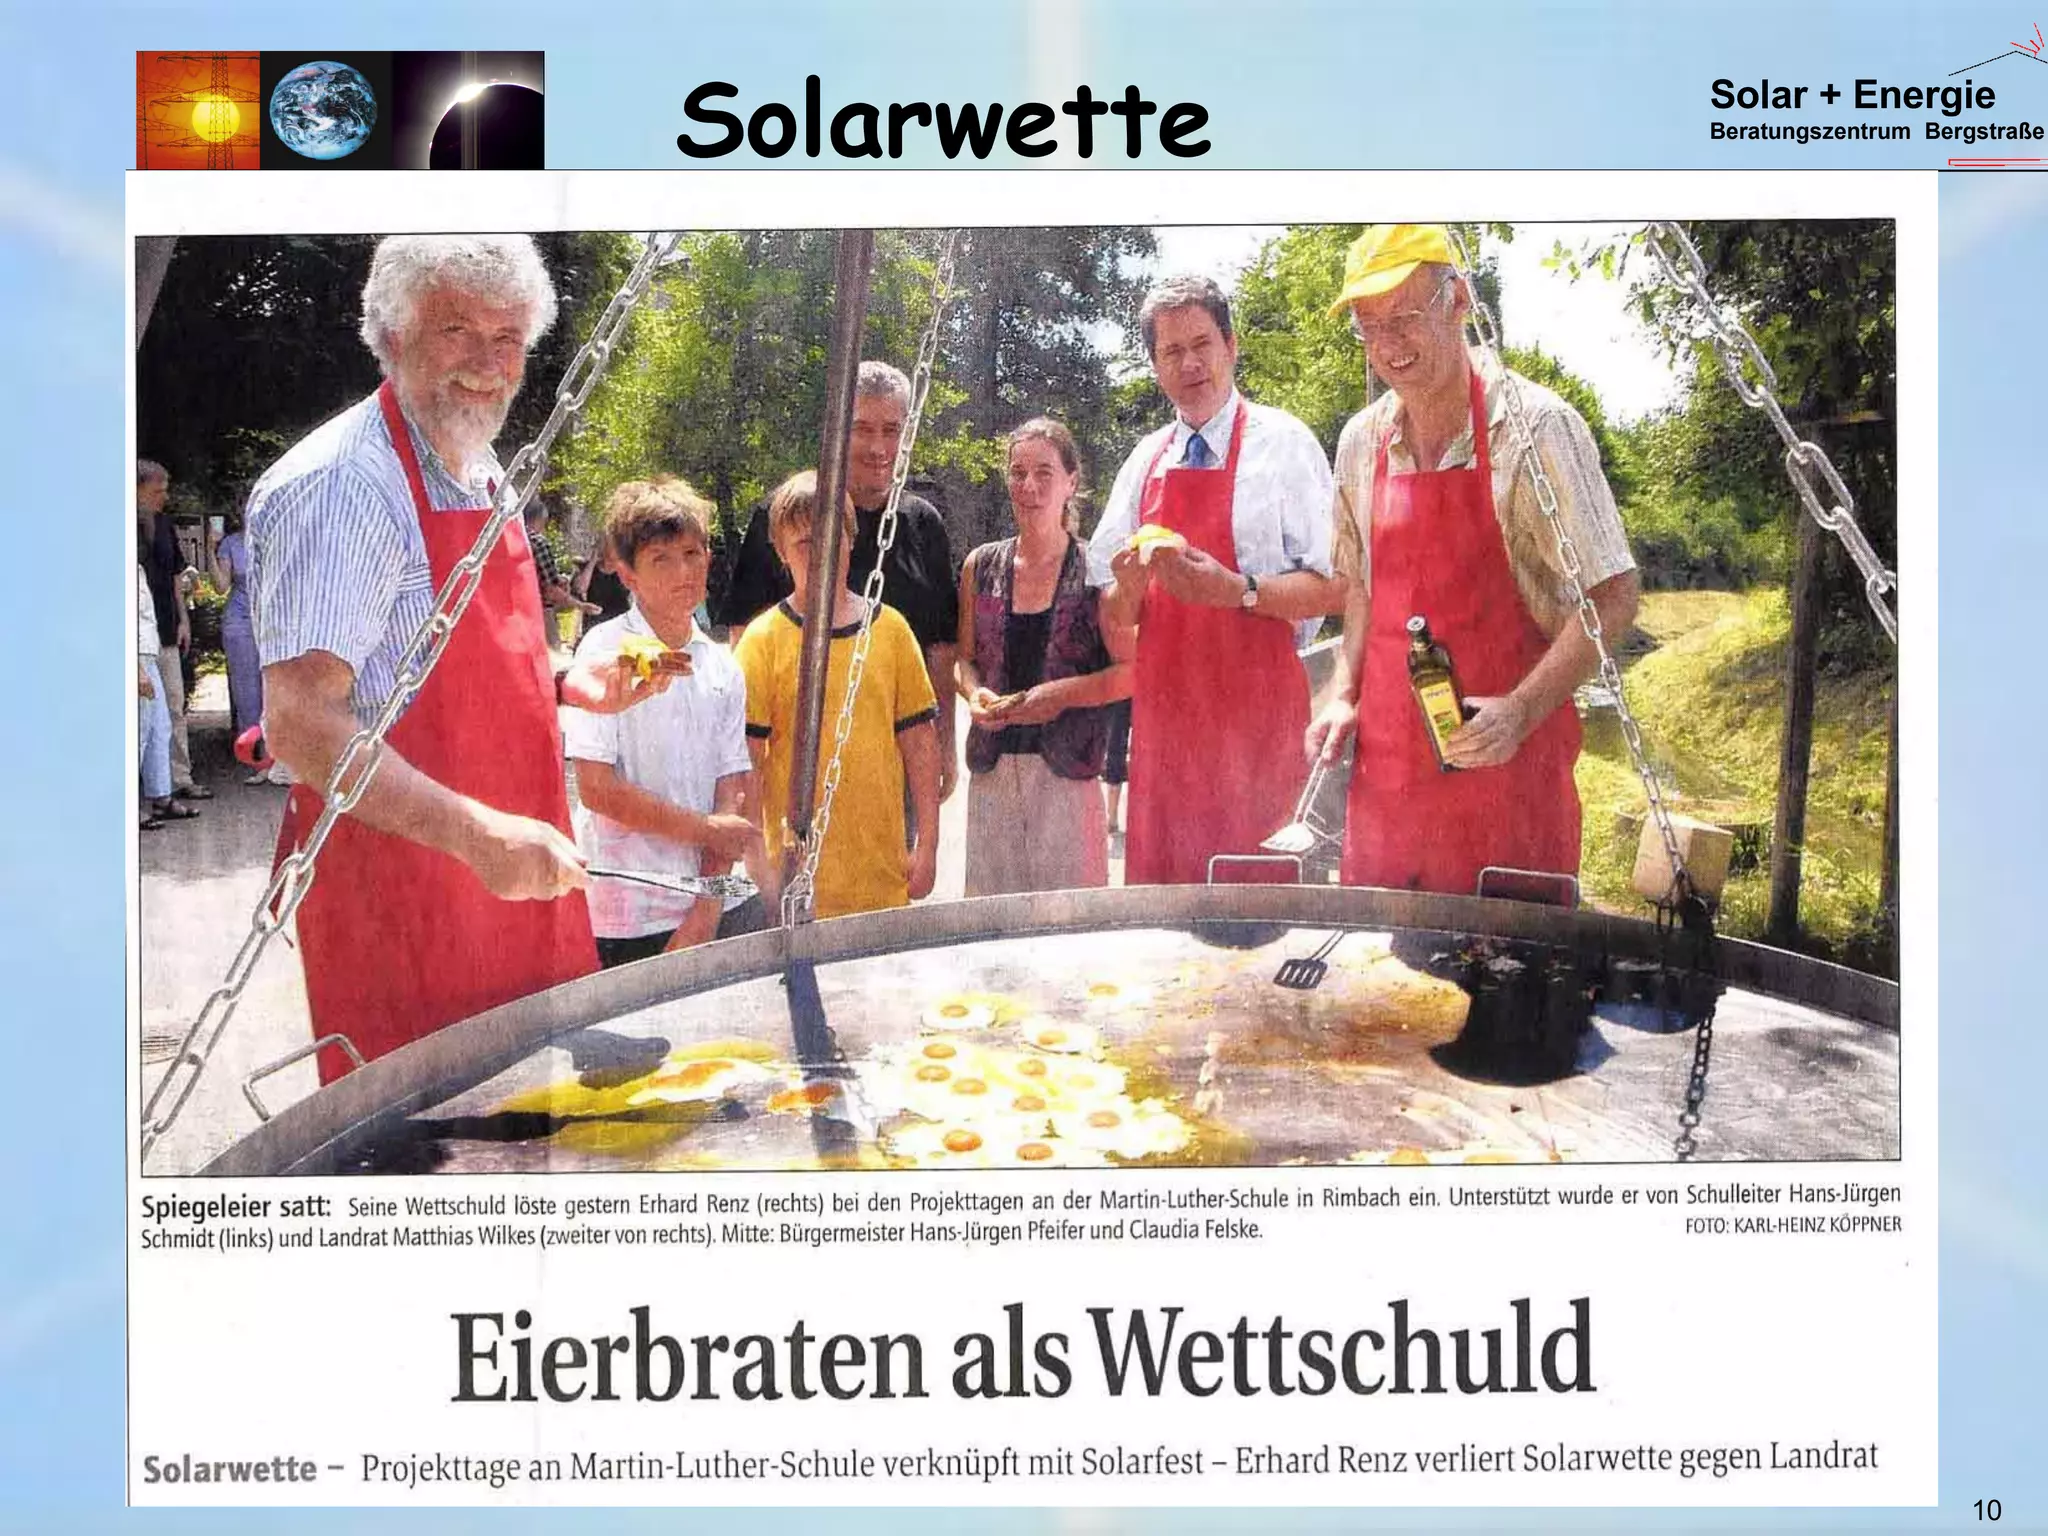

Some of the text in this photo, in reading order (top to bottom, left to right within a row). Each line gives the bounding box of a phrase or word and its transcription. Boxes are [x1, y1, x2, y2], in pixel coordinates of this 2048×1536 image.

[142, 1183, 1900, 1224] Spiegeleier satt: Seine Wettschuld löste gestern Erhard Renz (rechts) bei den Projekttagen an der Martin-Luther-Schule in Rimbach ein. Unterstützt wurde er von Schulleiter Hans-Jürgen
[1687, 1214, 1901, 1234] FOTO: KARL-HEINZ KÖPPNER
[142, 1218, 1262, 1252] Schmidt (links) und Landrat Matthias Wilkes (zweiter von rechts). Mitte: Bürgermeister Hans-Jürgen Pfeifer und Claudia Felske.
[451, 1297, 1597, 1402] Eierbraten als Wettschuld
[144, 1454, 316, 1483] Solarwette
[364, 1453, 520, 1489] Projekttage
[529, 1460, 560, 1480] an
[572, 1449, 874, 1479] Martin-Luther-Schule
[883, 1447, 1019, 1483] verknüpft
[1029, 1448, 1073, 1475] mit
[1083, 1446, 1203, 1475] Solarfest
[1237, 1444, 1329, 1473] Erhard
[1339, 1446, 1407, 1473] Renz
[1416, 1444, 1513, 1472] verliert
[1524, 1443, 1672, 1471] Solarwette
[1680, 1449, 1761, 1478] gegen
[1771, 1440, 1878, 1468] Landrat
